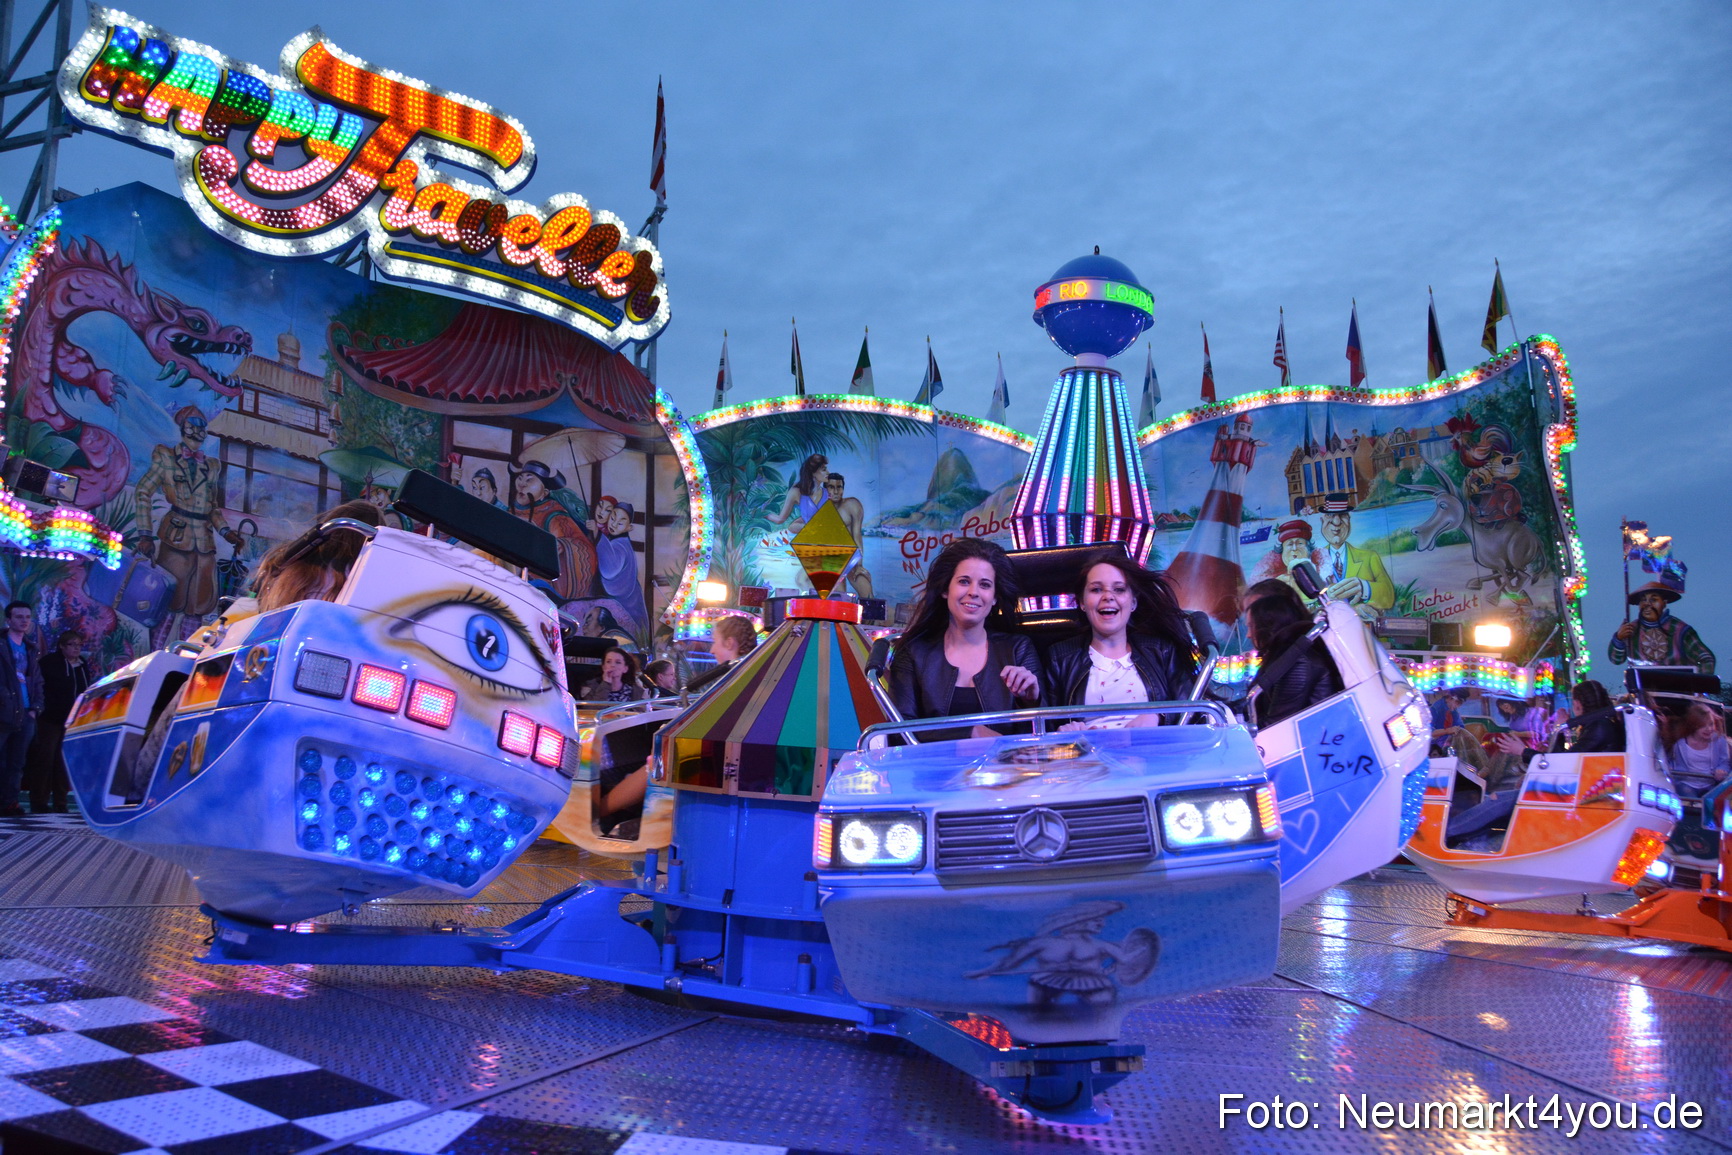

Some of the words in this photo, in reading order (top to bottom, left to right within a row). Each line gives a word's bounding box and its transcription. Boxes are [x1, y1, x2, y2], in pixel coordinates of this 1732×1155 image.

[194, 41, 660, 322] Traveller
[1059, 281, 1088, 299] RIO
[1105, 283, 1154, 314] LONDO
[899, 530, 953, 562] Copa
[1320, 729, 1345, 746] Le
